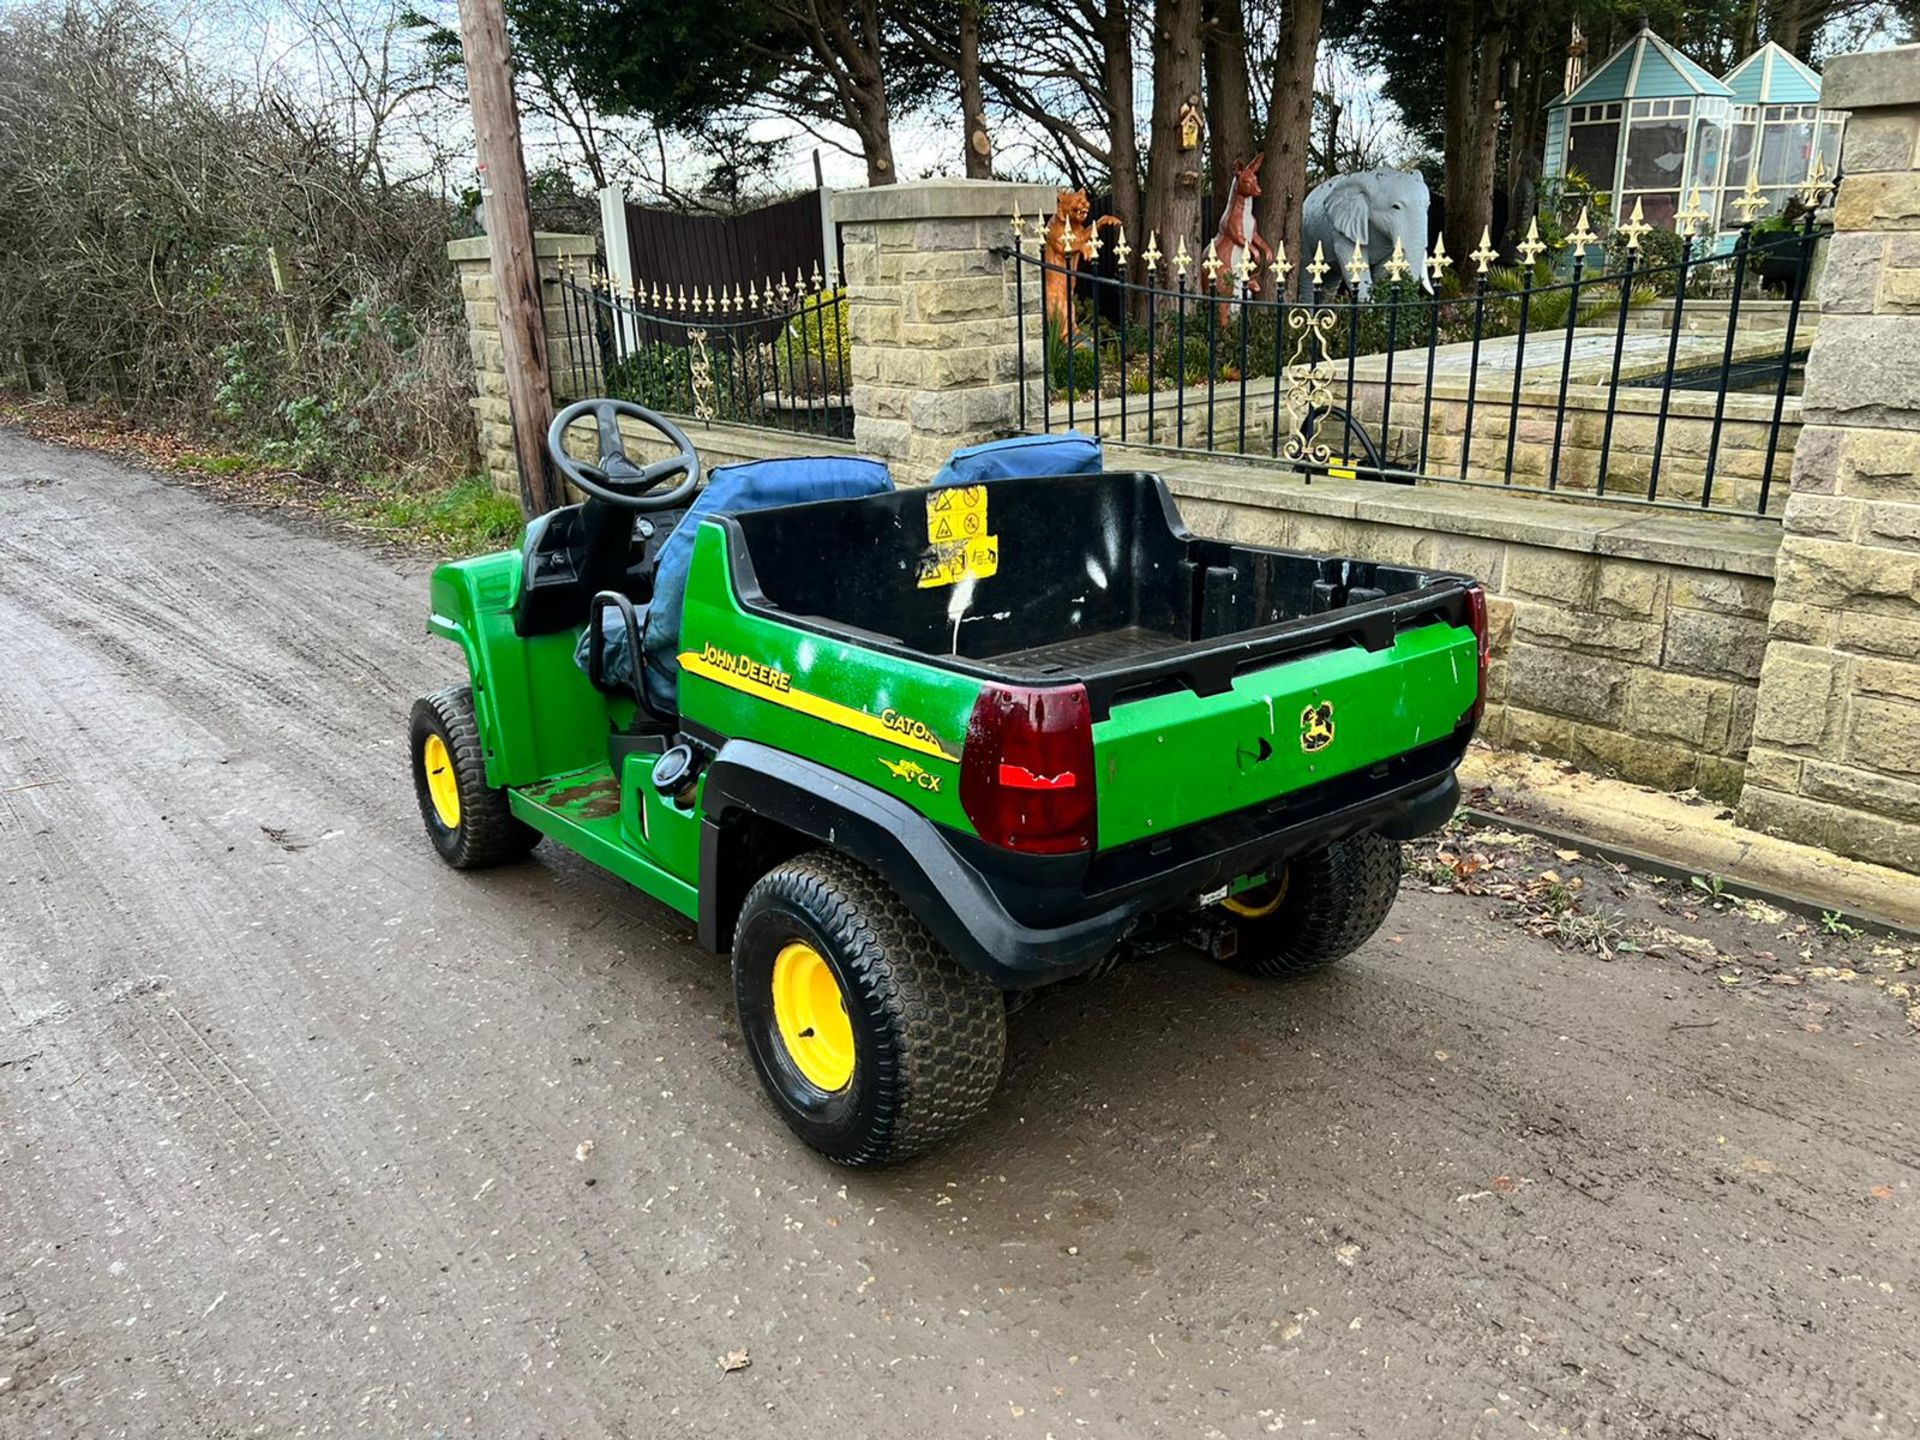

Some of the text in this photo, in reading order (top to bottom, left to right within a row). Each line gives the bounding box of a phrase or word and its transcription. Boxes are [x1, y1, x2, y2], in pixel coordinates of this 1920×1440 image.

[699, 641, 792, 693] JOHN DEERE
[917, 772, 943, 793] CX
